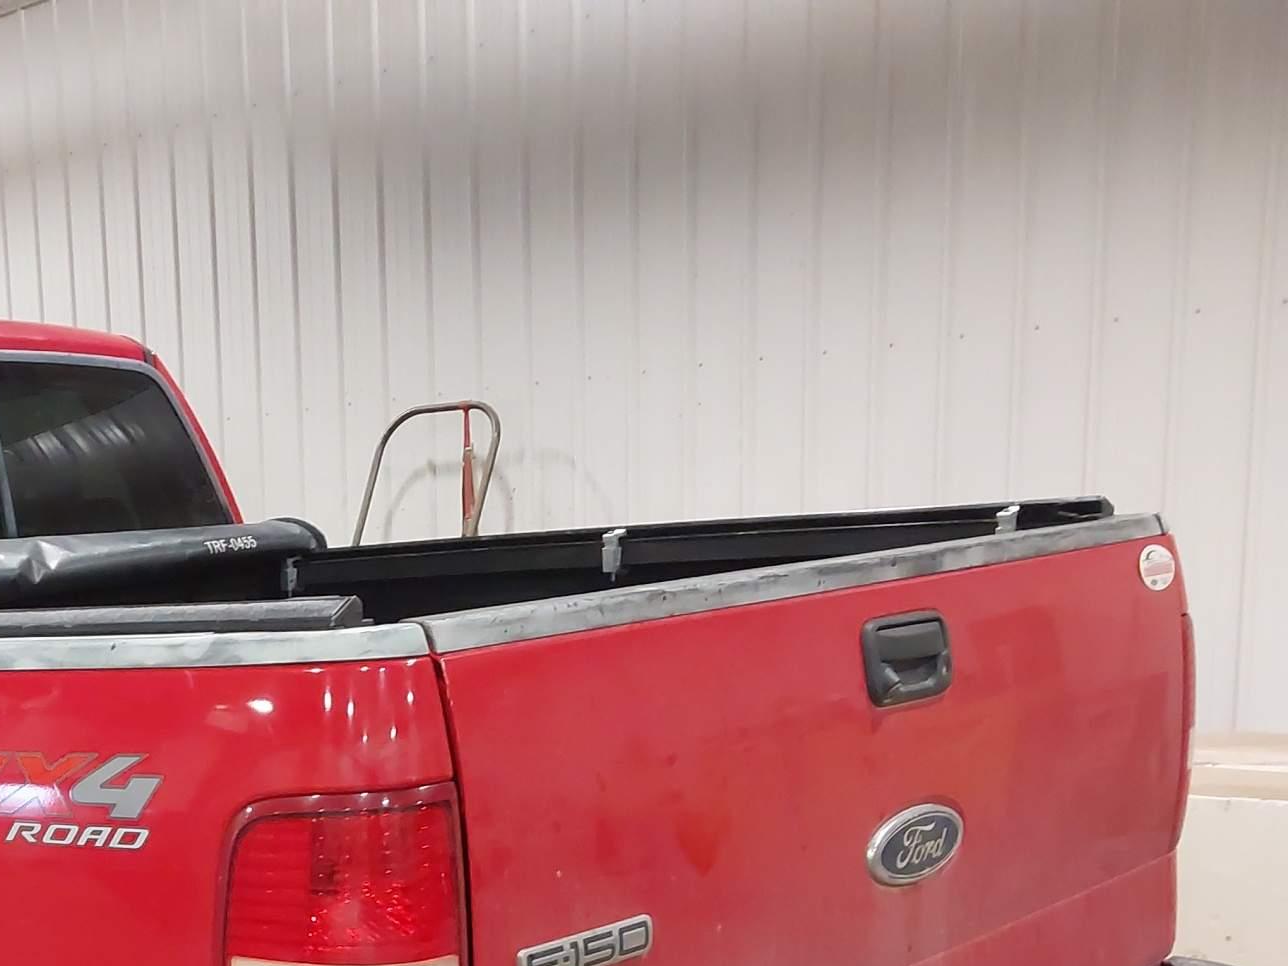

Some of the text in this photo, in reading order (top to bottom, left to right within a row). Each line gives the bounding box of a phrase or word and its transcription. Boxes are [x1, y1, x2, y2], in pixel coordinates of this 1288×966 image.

[204, 535, 257, 554] TRF-0455
[5, 822, 150, 850] ROAD
[896, 821, 948, 869] Ford
